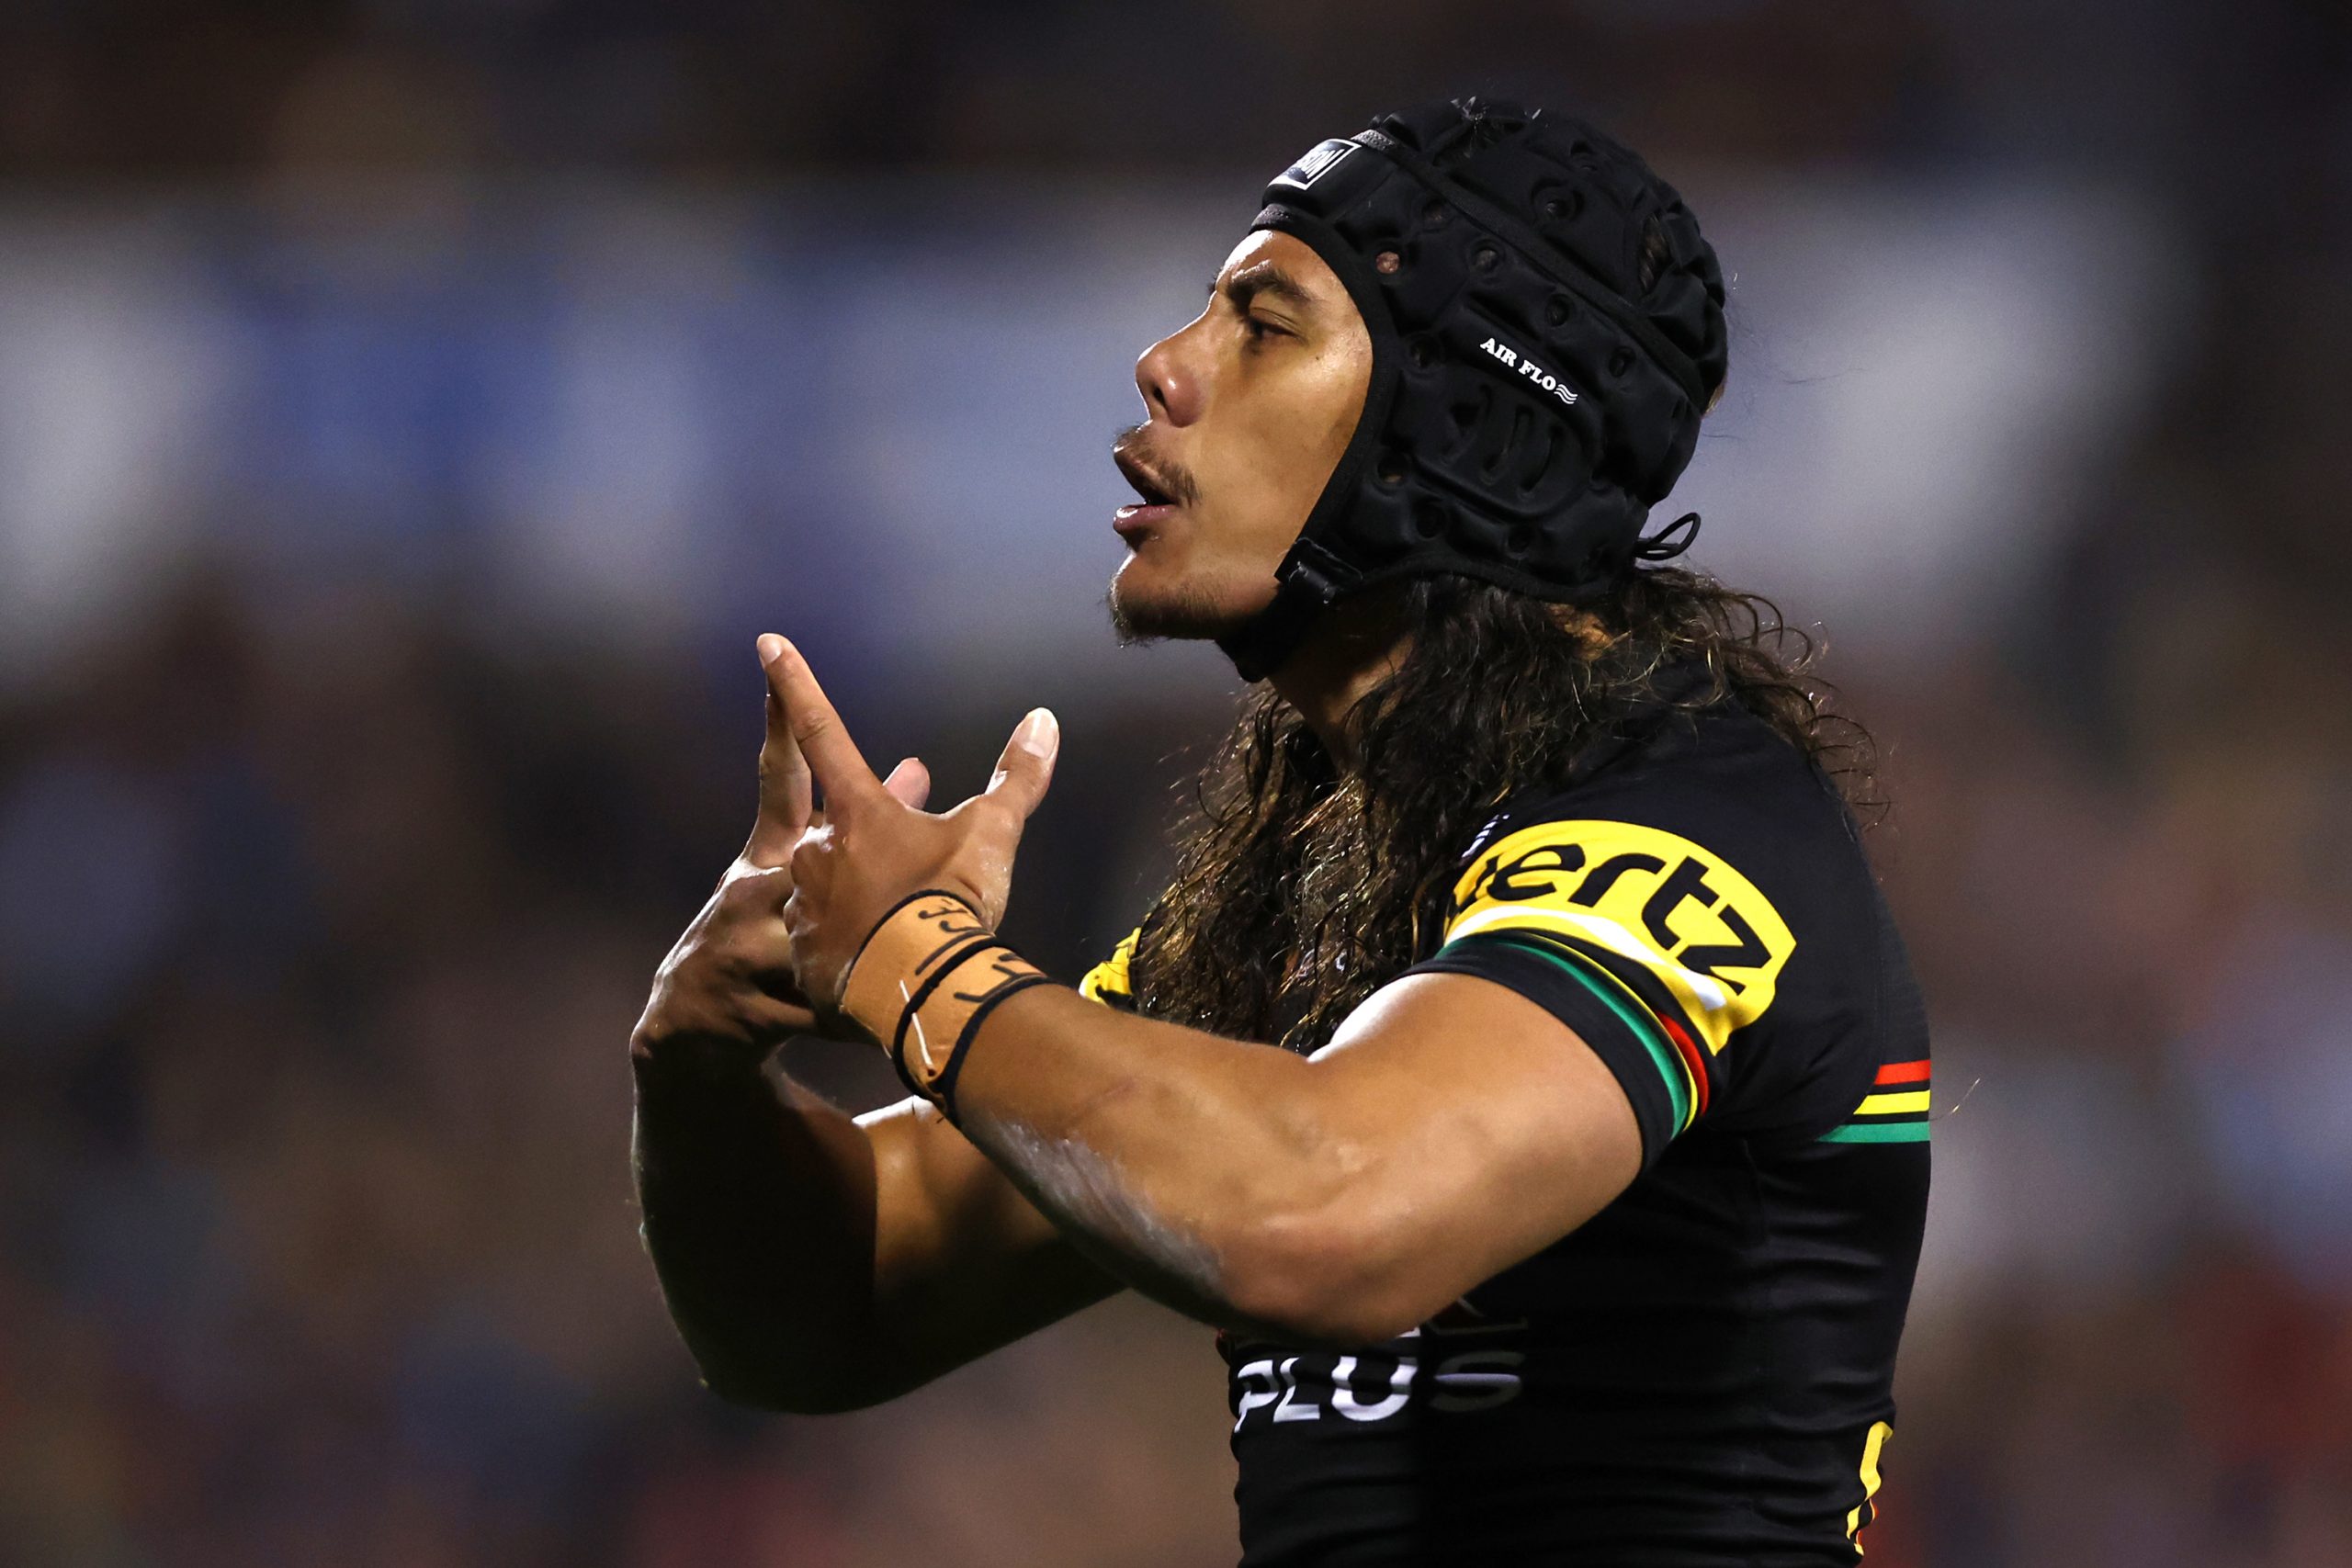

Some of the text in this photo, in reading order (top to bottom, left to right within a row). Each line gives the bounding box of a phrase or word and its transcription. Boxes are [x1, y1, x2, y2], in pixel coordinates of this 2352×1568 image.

[1479, 337, 1556, 392] AIR FLO
[1233, 1350, 1526, 1434] PLUS
